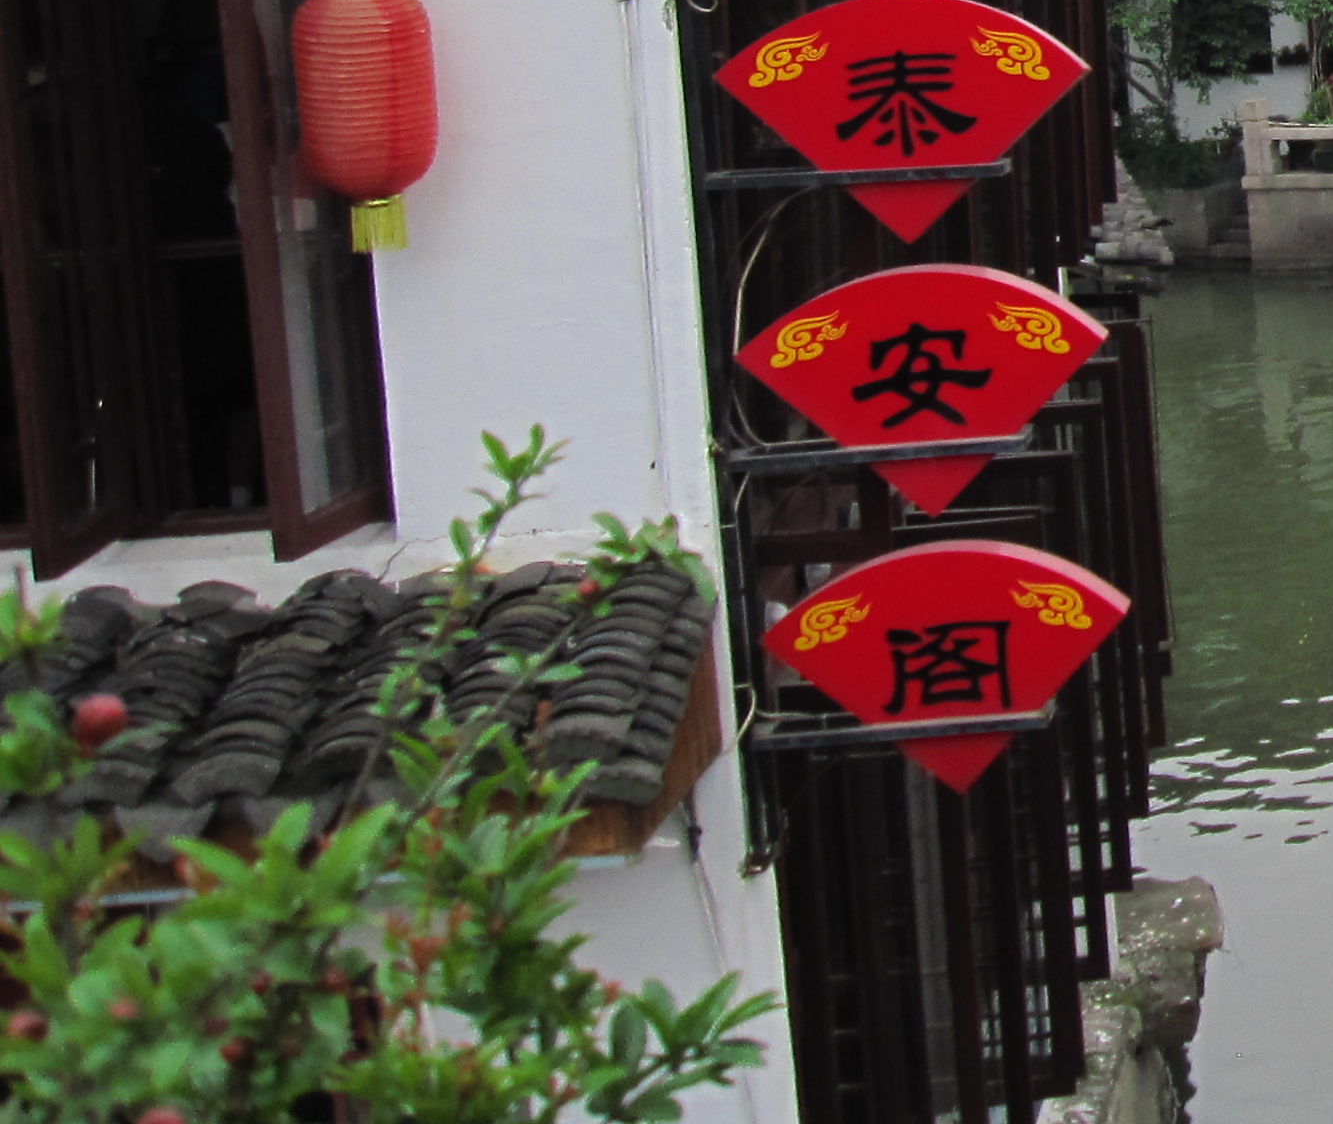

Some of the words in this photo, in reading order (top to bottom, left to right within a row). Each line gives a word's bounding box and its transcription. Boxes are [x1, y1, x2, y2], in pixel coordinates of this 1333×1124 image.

[837, 51, 977, 157] 泰
[853, 323, 992, 428] 安
[883, 621, 1012, 714] 阁
